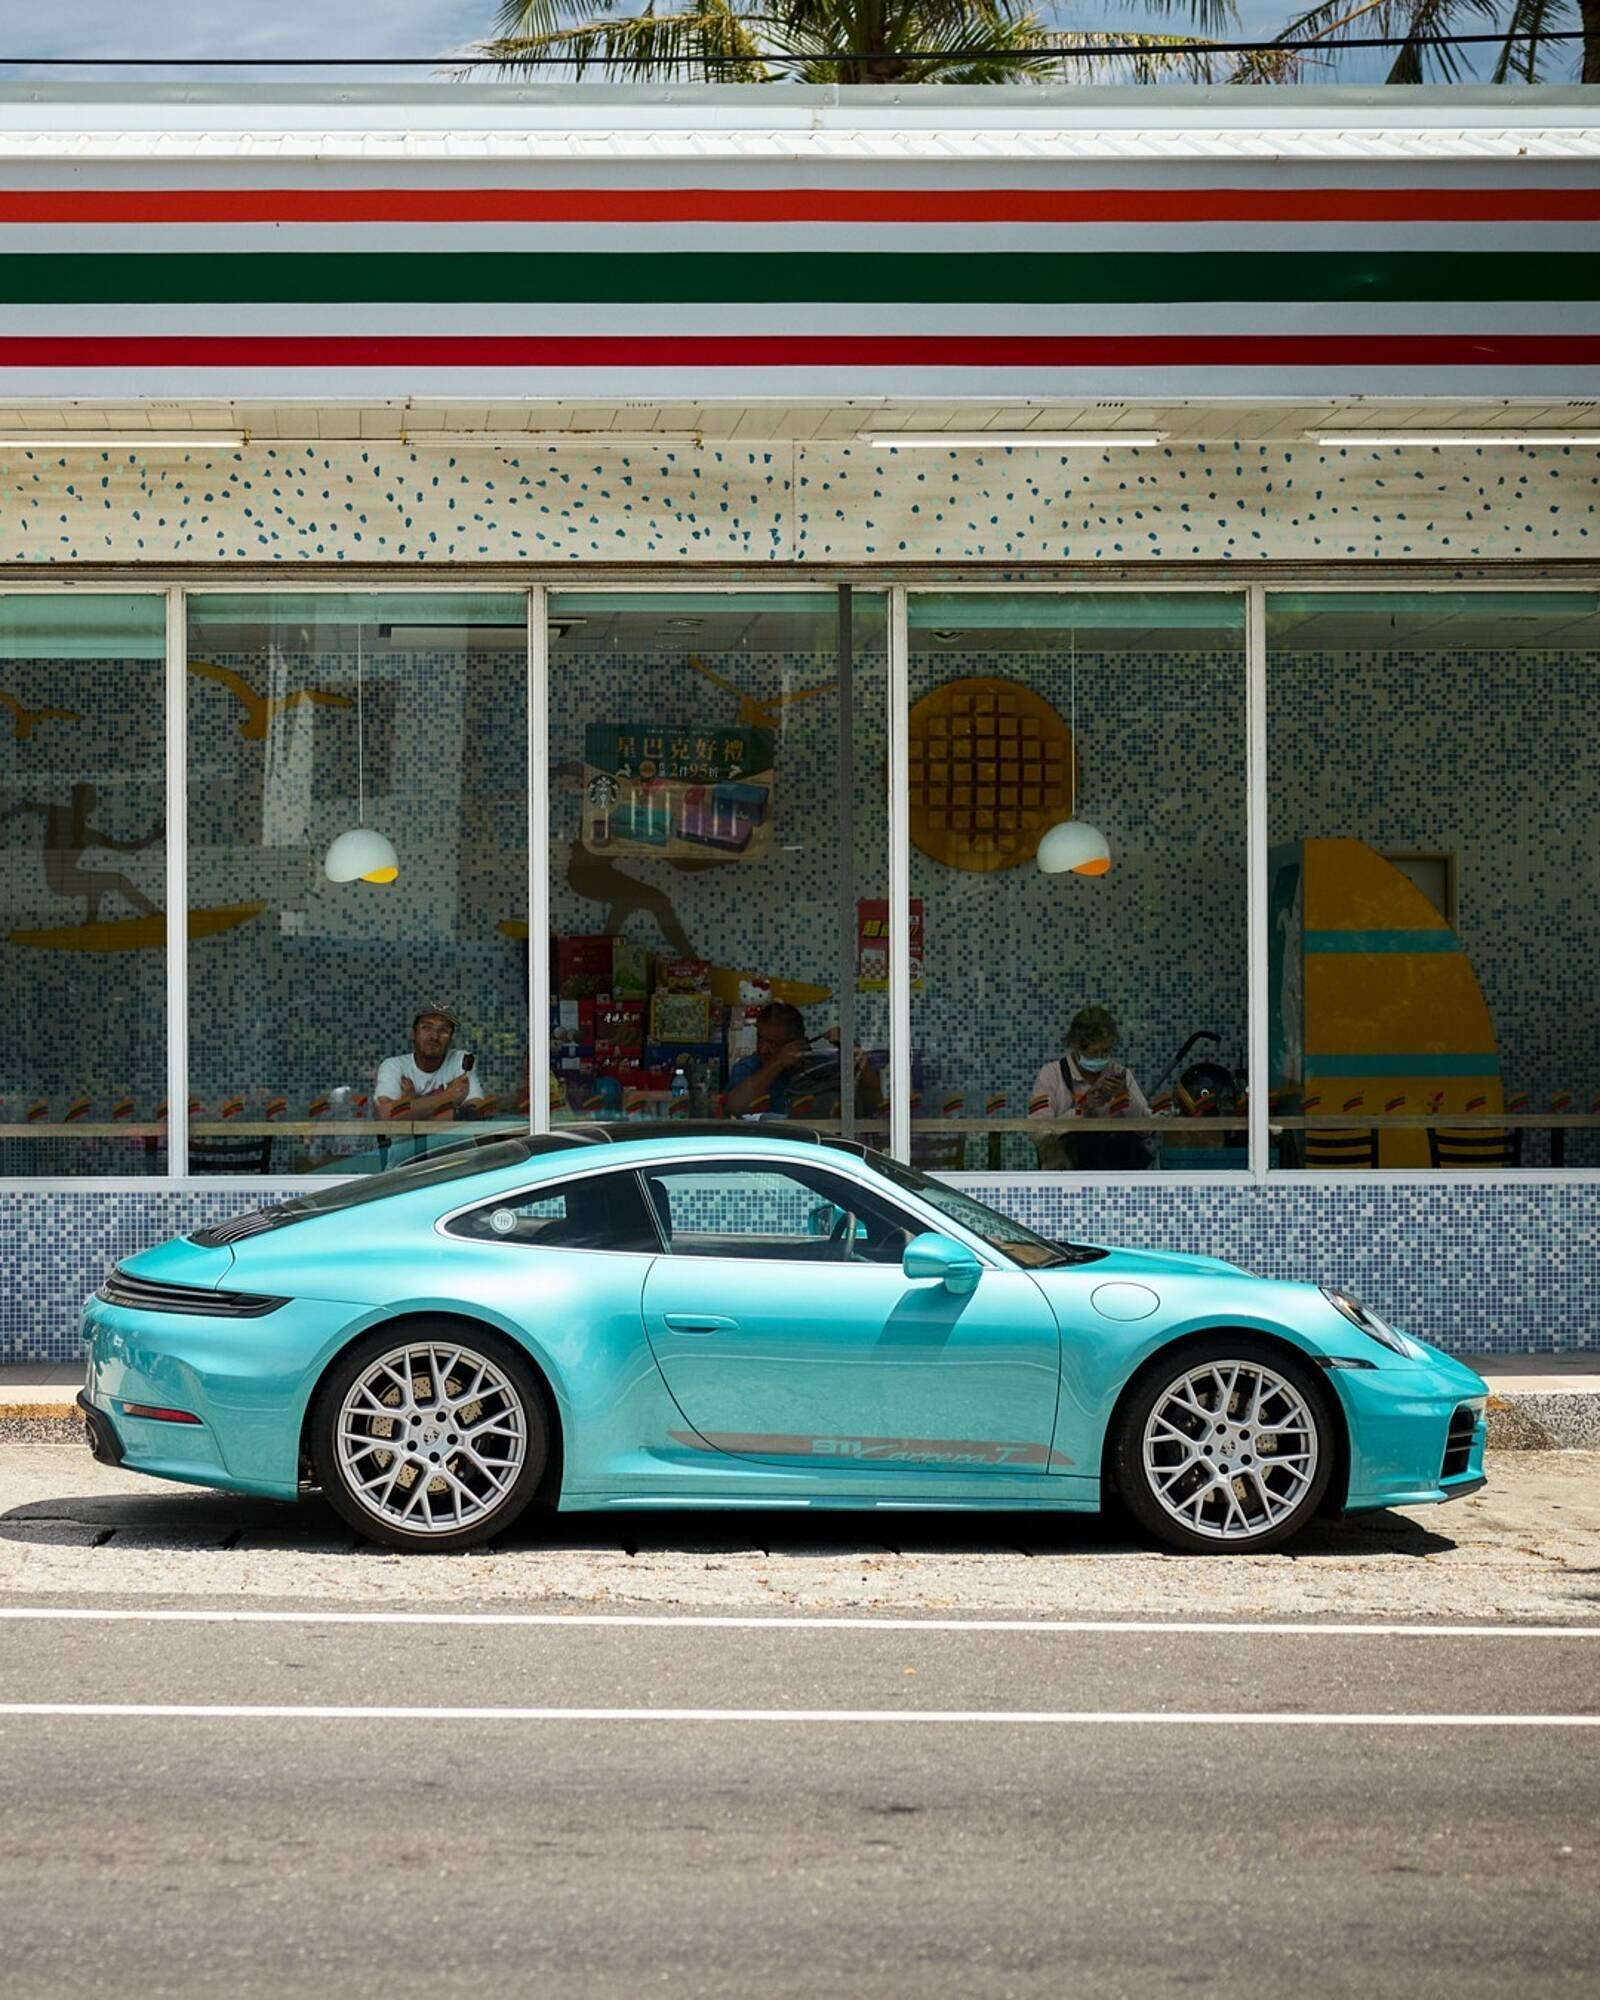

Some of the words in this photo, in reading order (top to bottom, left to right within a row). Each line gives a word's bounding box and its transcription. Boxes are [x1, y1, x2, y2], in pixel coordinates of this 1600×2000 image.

[812, 1438, 862, 1456] 911
[853, 1444, 990, 1465] Carrera
[990, 1446, 1029, 1466] T
